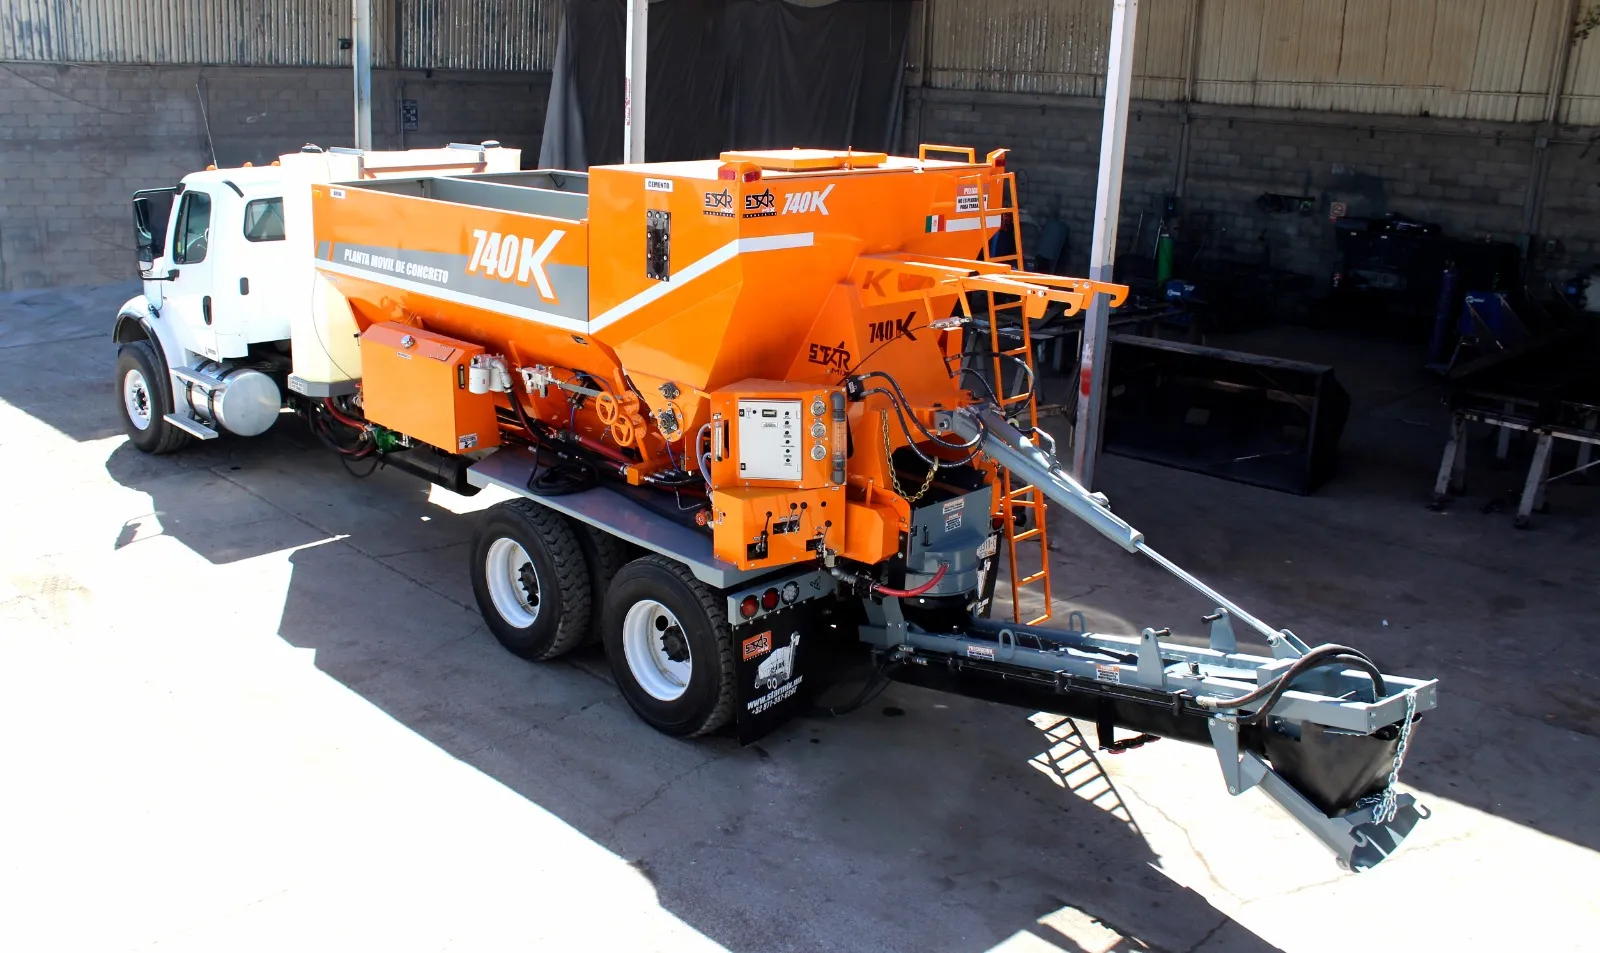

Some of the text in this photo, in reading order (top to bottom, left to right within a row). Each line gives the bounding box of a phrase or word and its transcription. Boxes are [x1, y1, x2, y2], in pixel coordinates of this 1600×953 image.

[647, 180, 670, 190] CEMENTO
[704, 188, 733, 208] STAR
[744, 187, 775, 210] STAR
[781, 183, 836, 216] 740K
[344, 248, 449, 284] PLANTA MOVIL DE CONCRETO
[468, 228, 567, 300] 740K
[861, 268, 894, 298] K
[868, 311, 918, 344] 740K
[808, 340, 851, 371] STAR
[745, 633, 769, 655] STAR
